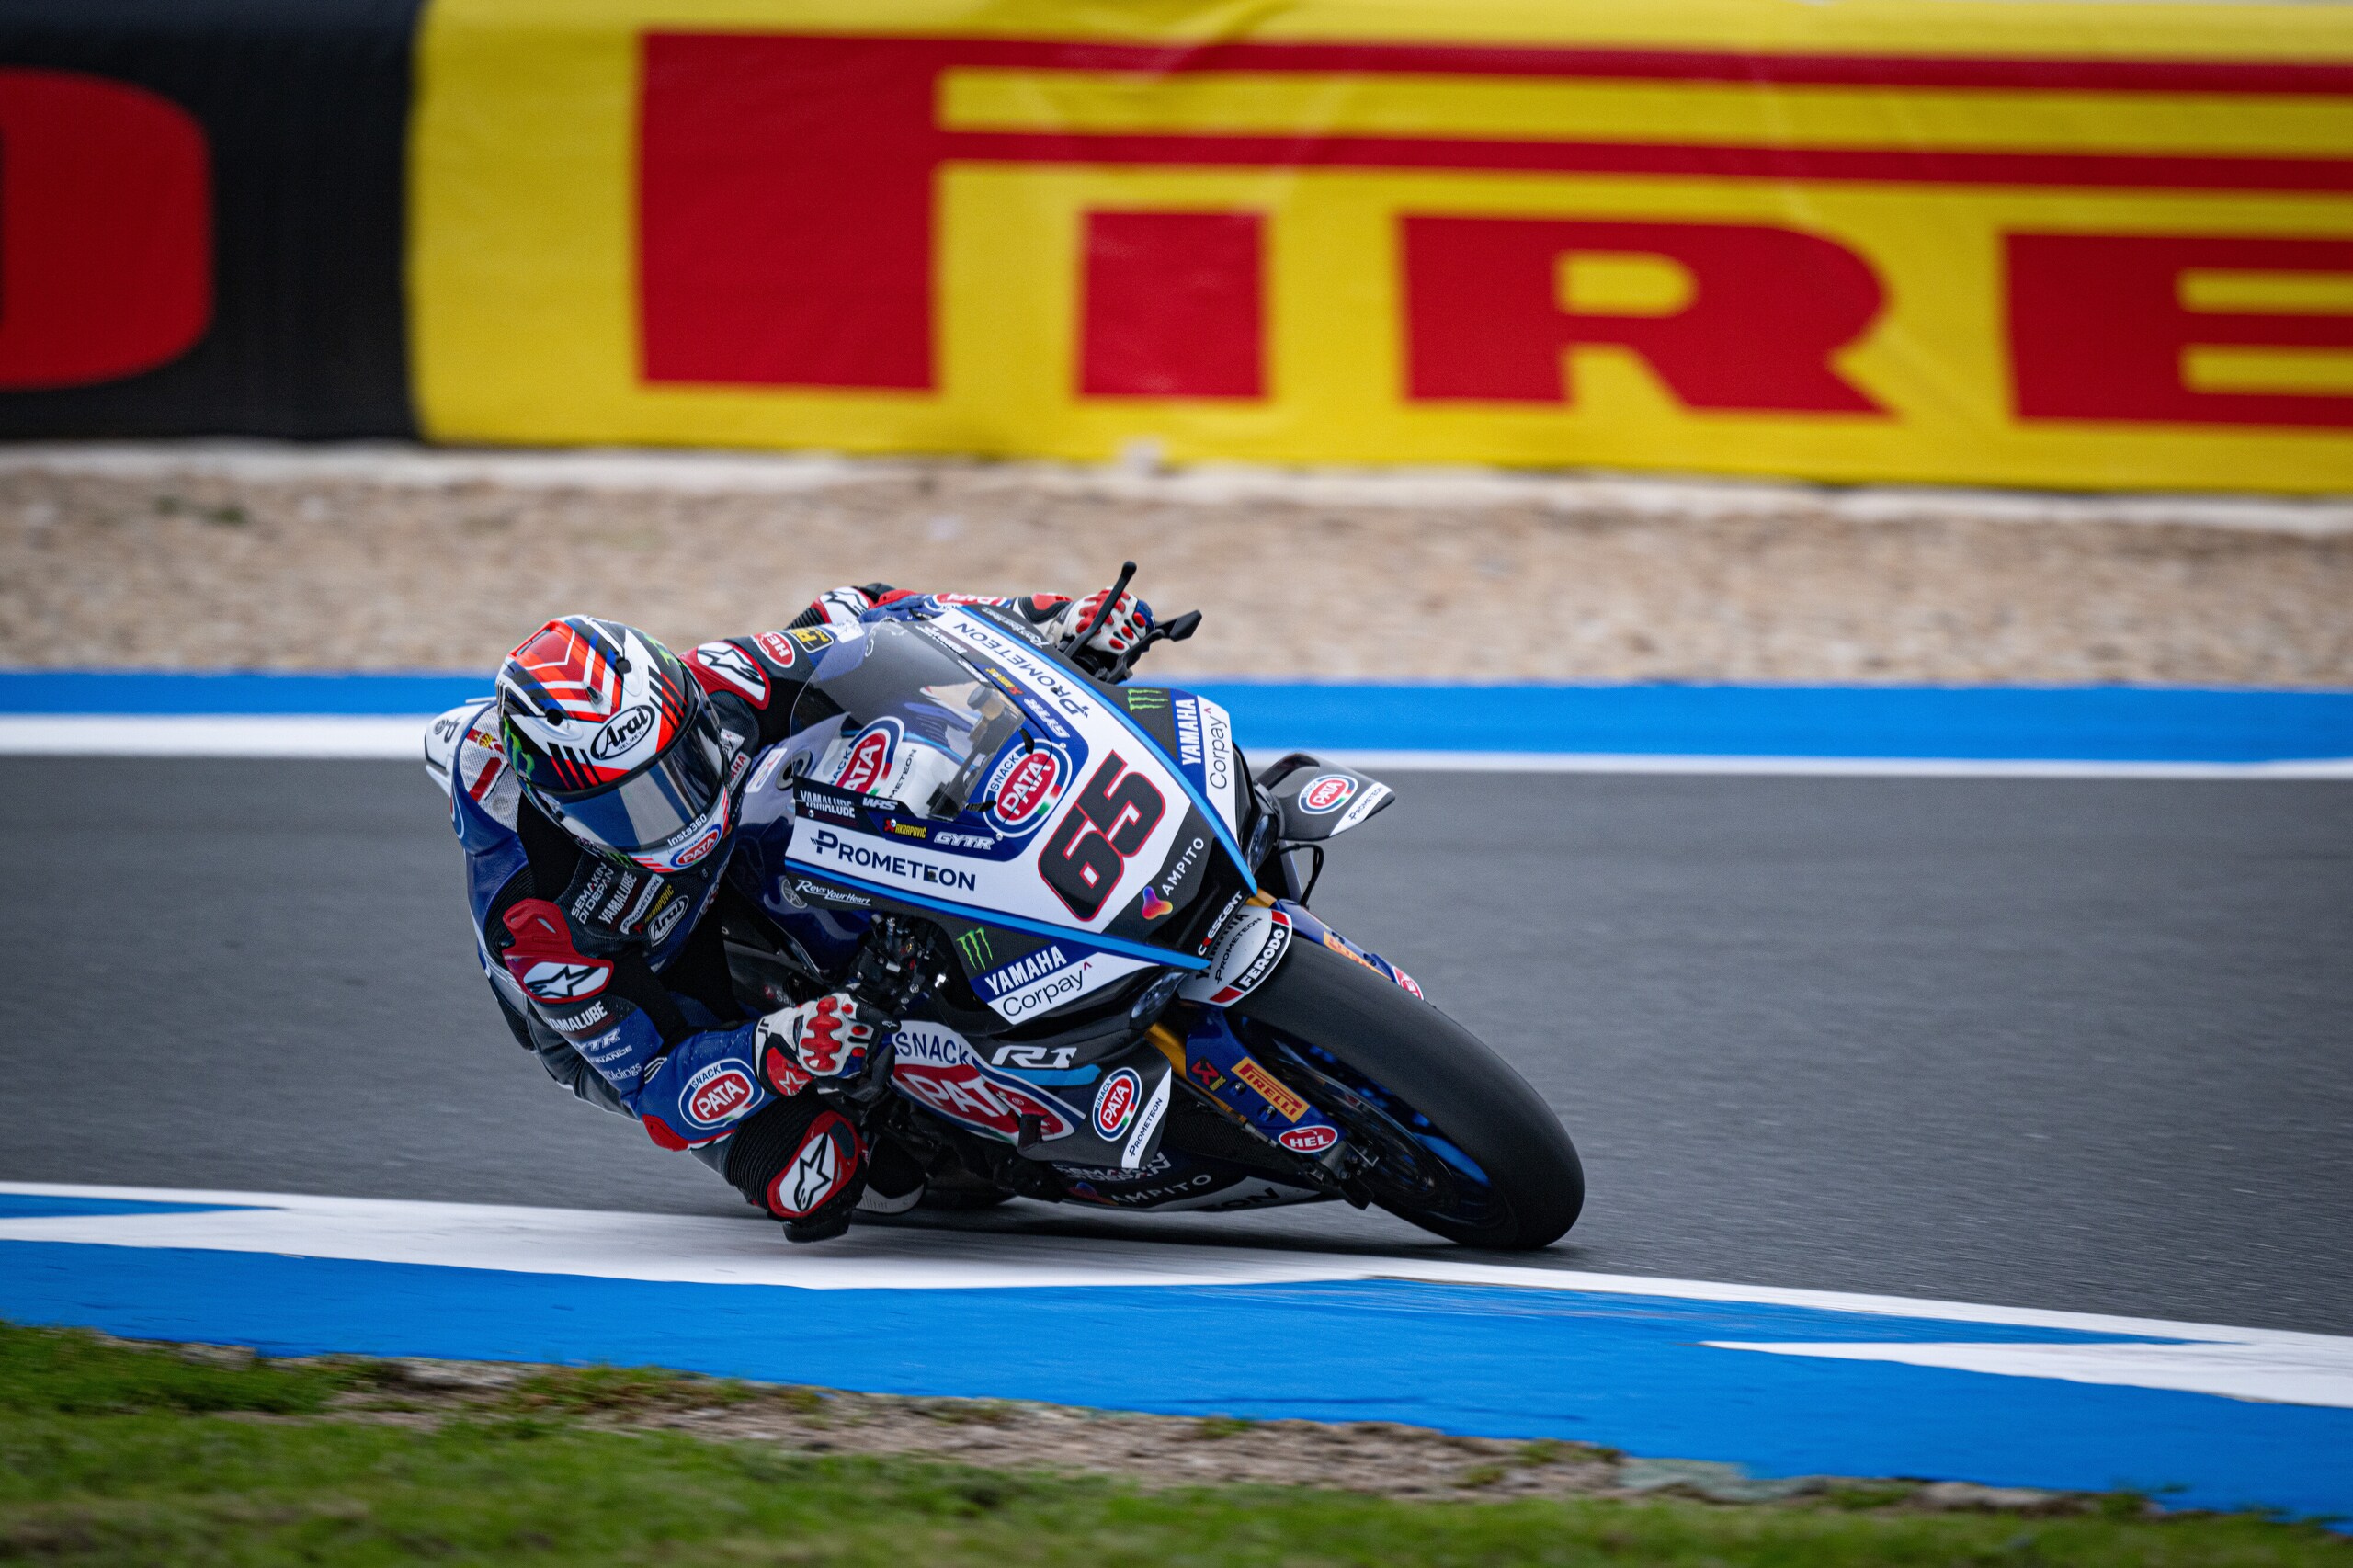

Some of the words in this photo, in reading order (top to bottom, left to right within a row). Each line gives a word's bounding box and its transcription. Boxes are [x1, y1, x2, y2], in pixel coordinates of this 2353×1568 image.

[953, 623, 1089, 719] PROMETEON
[599, 707, 649, 757] Arai
[1176, 699, 1202, 765] YAMAHA
[1210, 715, 1228, 790] Corpay
[842, 744, 882, 792] ATA
[888, 748, 918, 799] METEON
[990, 754, 1020, 791] SNACK
[1000, 761, 1051, 816] PATA
[862, 797, 899, 811] WRS
[1312, 783, 1343, 805] PATA
[667, 813, 707, 846] Insta360
[683, 837, 715, 863] PATA
[933, 831, 995, 850] GYTR
[1037, 749, 1166, 922] 65
[810, 829, 976, 892] PROMETEON
[1161, 837, 1204, 896] AMPITO
[571, 861, 608, 918] SEMAKIN
[598, 869, 637, 925] YAMALUBE
[796, 879, 826, 895] Revs
[824, 889, 849, 904] Your
[847, 892, 871, 904] Heart
[578, 907, 591, 925] DI
[985, 945, 1067, 995] YAMAHA
[1214, 917, 1262, 985] PROMETEON
[1238, 928, 1285, 988] FERODO
[546, 1000, 608, 1031] YAMALUBE
[1002, 970, 1085, 1017] Corpay
[895, 1031, 970, 1066] SNACK
[991, 1045, 1077, 1069] R1
[691, 1064, 722, 1090] SNACK
[697, 1080, 745, 1119] PATA
[1096, 1080, 1112, 1108] SNACK
[1239, 1063, 1302, 1116] PIRELLI
[1103, 1085, 1130, 1126] PATA
[1129, 1097, 1163, 1157] PROMETEON
[1290, 1135, 1329, 1148] HEL
[1112, 1175, 1211, 1203] AMPITO
